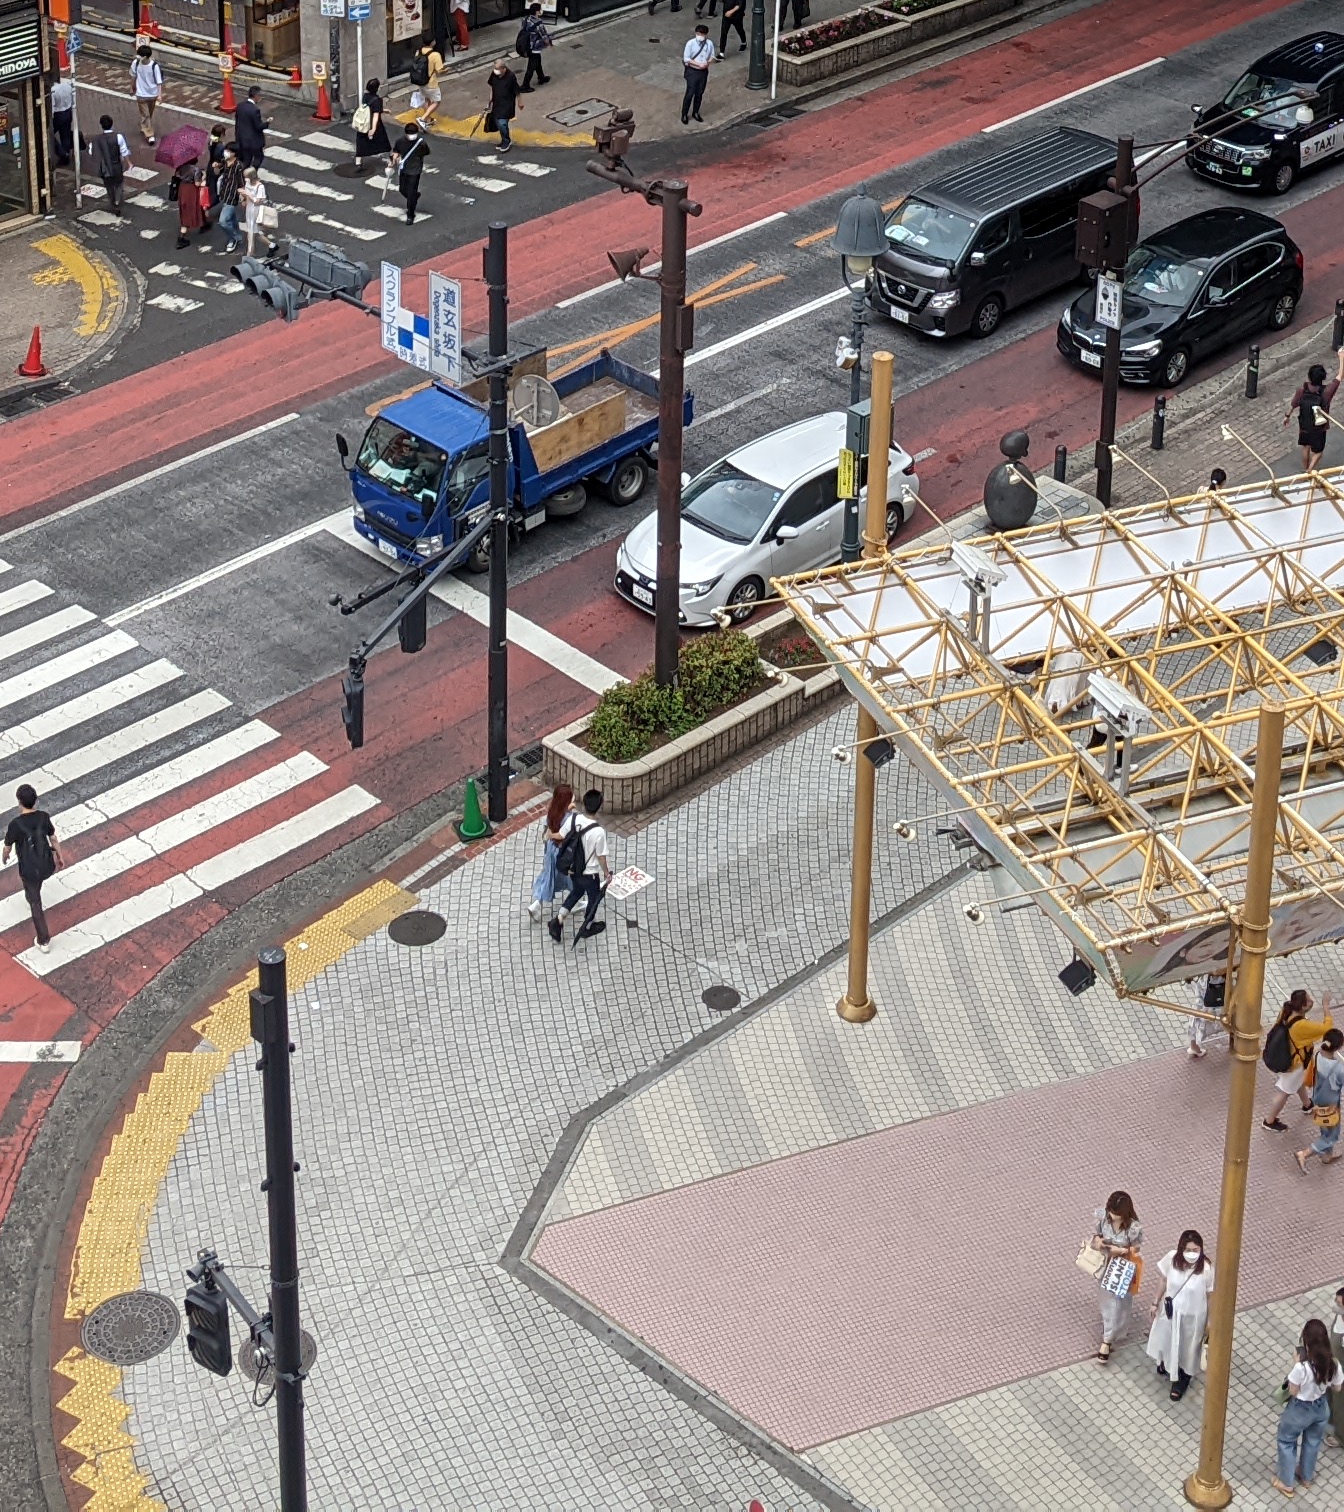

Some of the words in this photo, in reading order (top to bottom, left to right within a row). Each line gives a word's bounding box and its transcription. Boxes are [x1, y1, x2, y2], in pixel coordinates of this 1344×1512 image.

[1313, 133, 1336, 154] TAXI
[385, 267, 397, 350] スクランブル式
[433, 290, 442, 336] Dogenzaka
[442, 285, 458, 373] 道玄坂下
